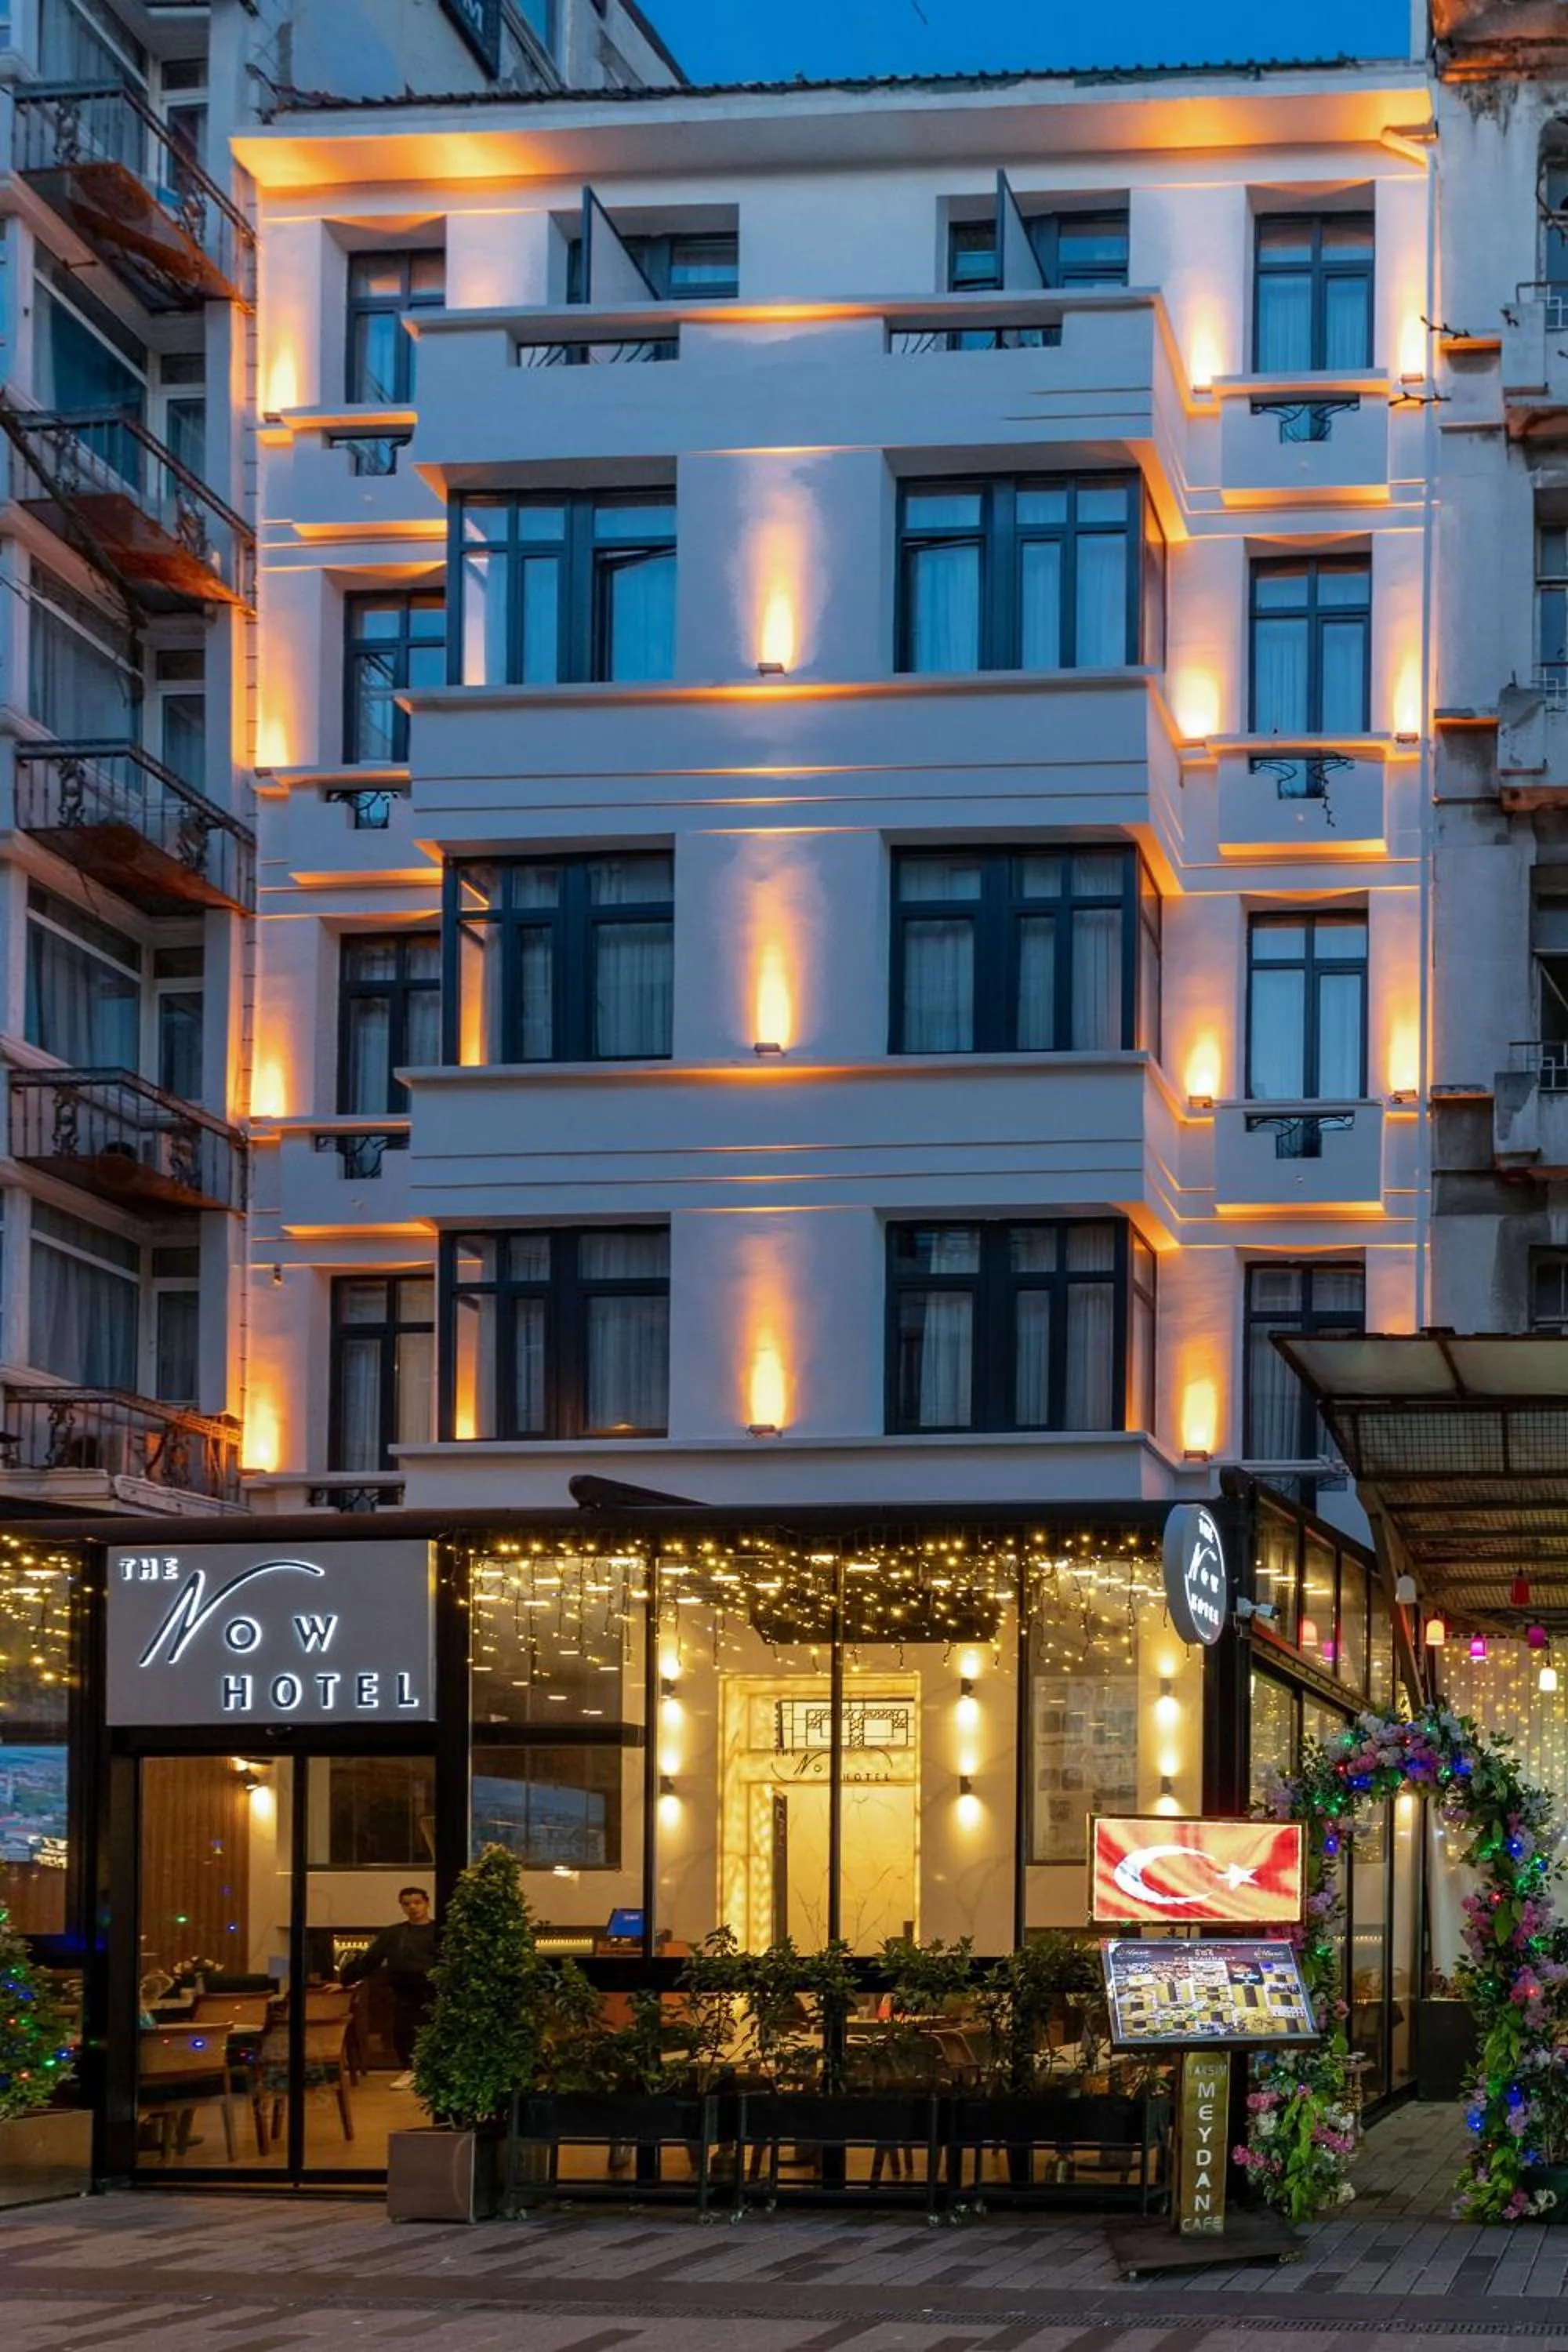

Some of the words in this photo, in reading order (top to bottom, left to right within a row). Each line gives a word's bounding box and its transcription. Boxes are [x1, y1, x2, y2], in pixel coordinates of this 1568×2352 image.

[120, 1558, 180, 1581] THE
[223, 1672, 420, 1710] HOTEL
[1194, 2082, 1216, 2212] MEYDAN
